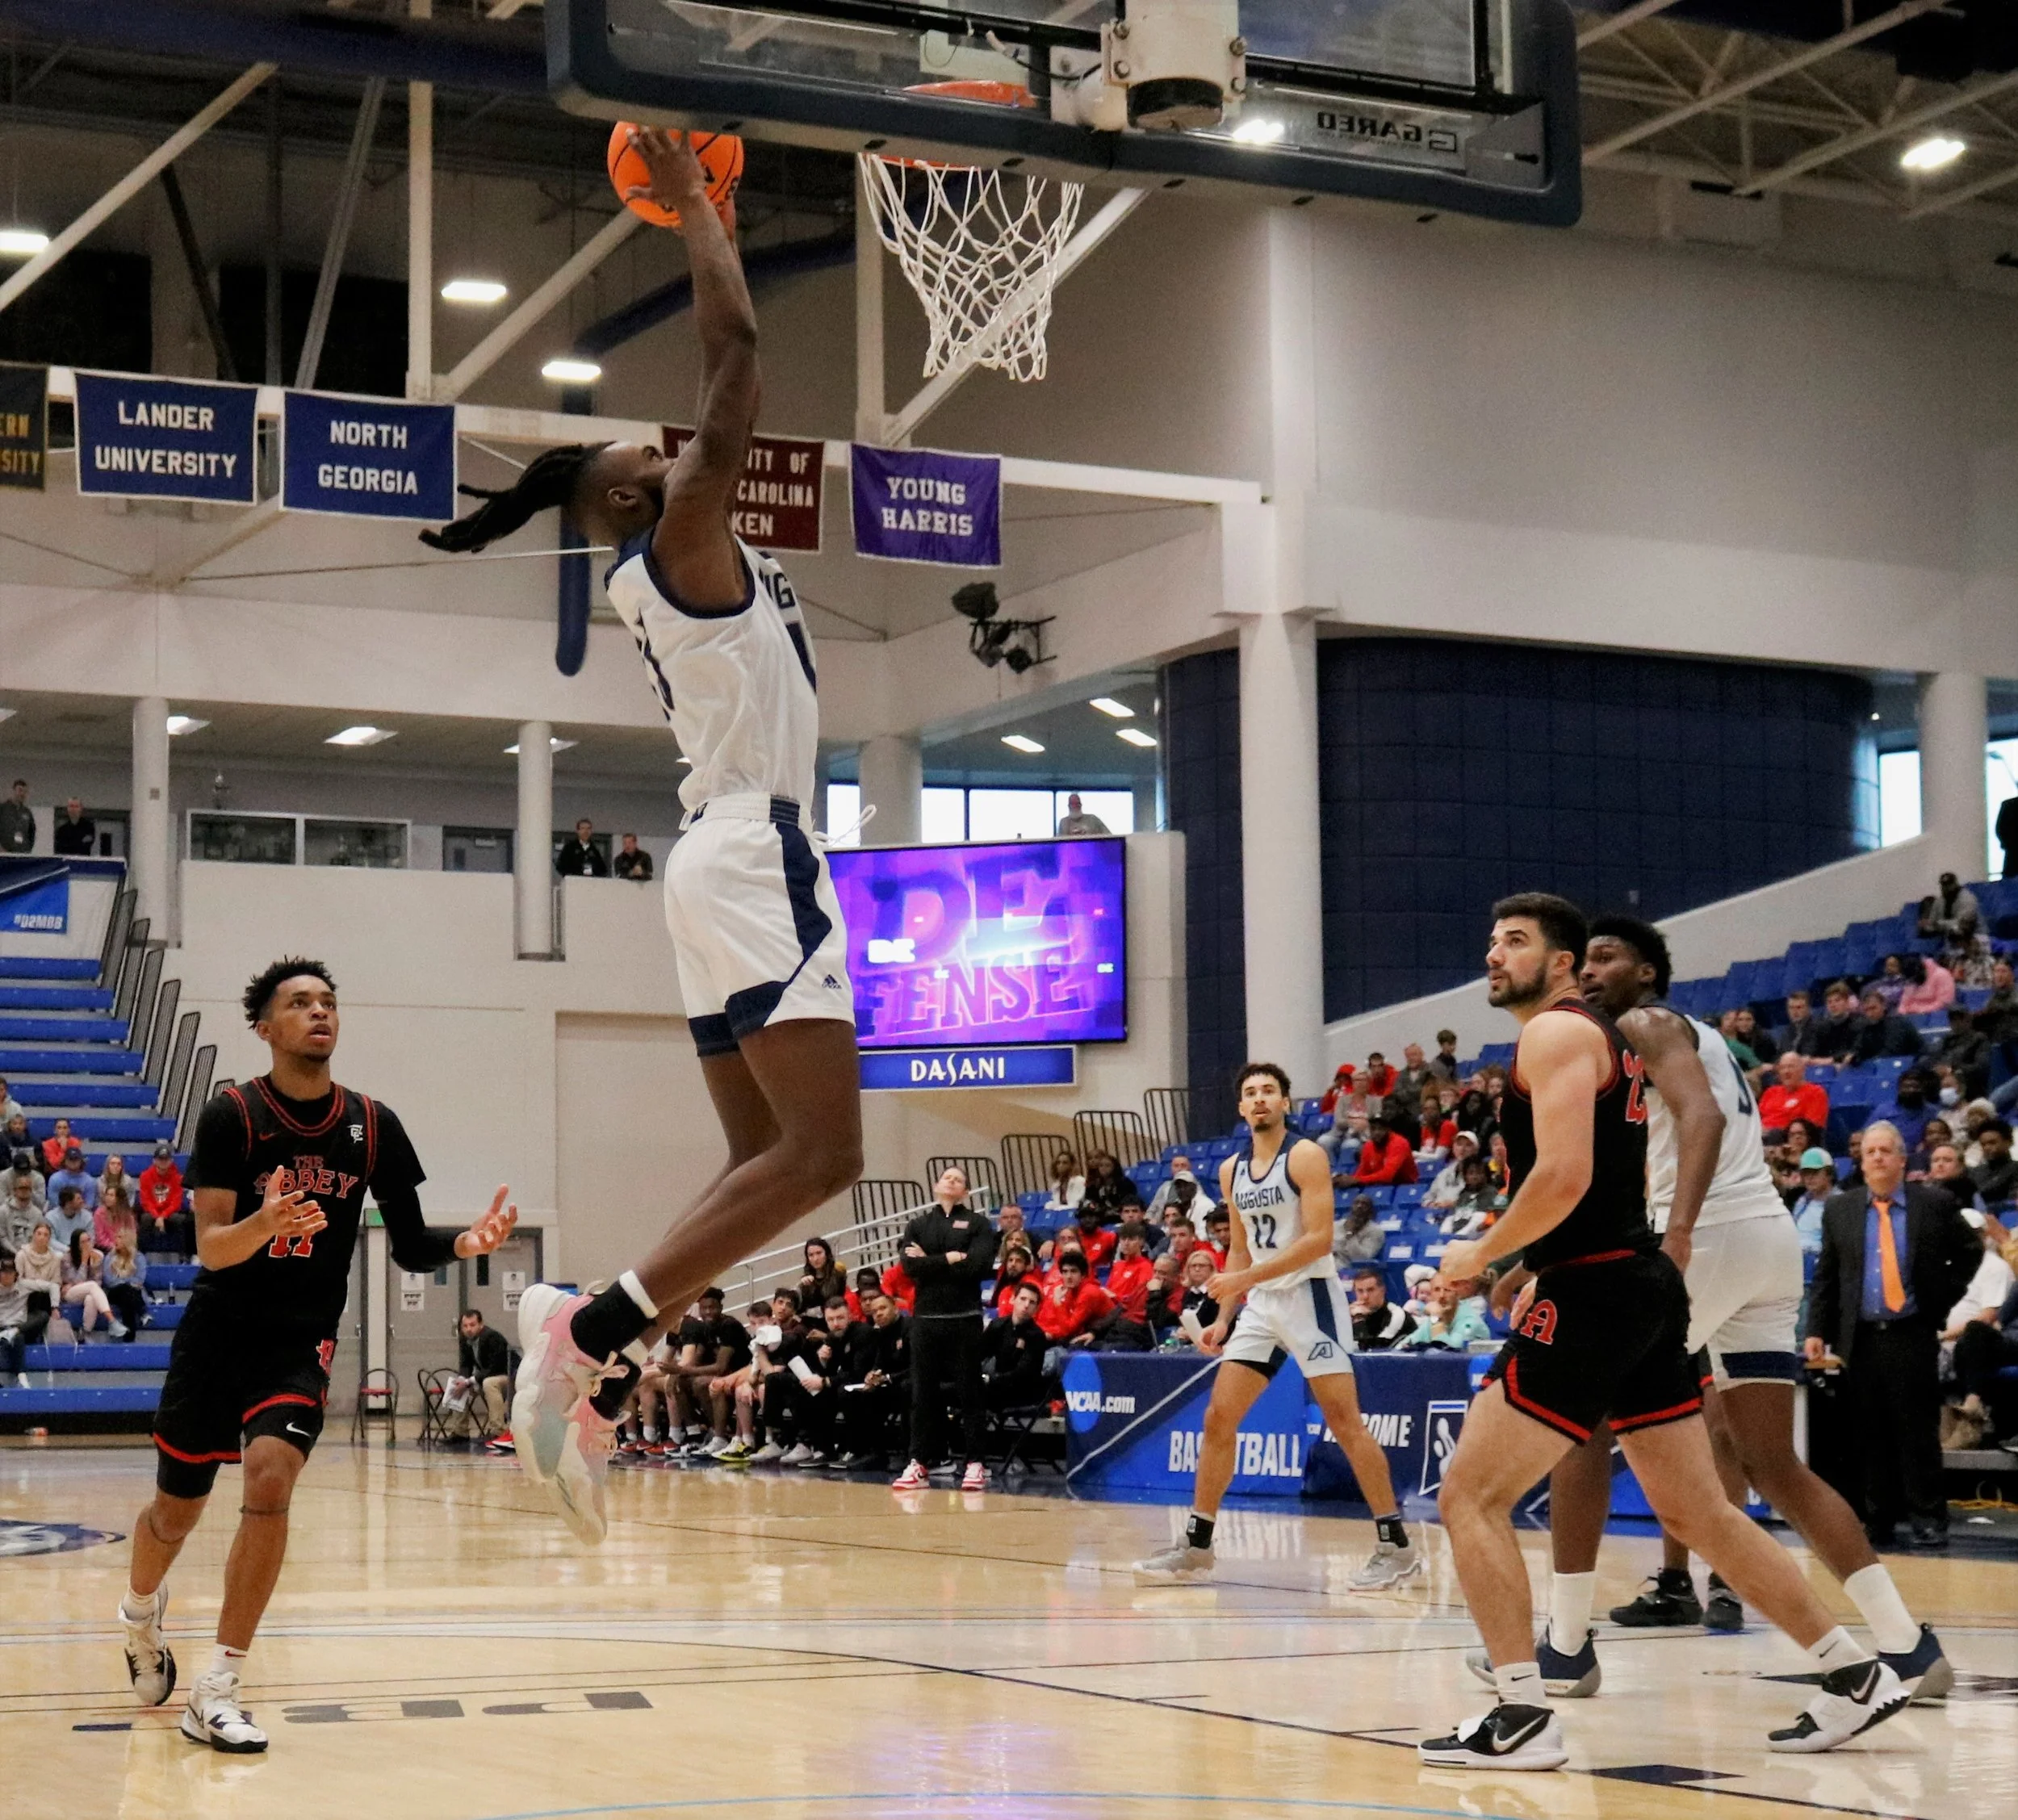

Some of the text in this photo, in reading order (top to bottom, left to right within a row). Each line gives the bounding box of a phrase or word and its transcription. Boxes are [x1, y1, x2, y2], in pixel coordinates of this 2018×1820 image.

[119, 401, 214, 432] LANDER
[330, 420, 408, 450] NORTH
[94, 445, 237, 479] UNIVERSITY
[789, 451, 810, 475] OF
[318, 463, 418, 495] GEORGIA
[737, 479, 814, 508] CAROLINA
[886, 476, 966, 505] YOUNG
[881, 507, 973, 537] HARRIS
[911, 1052, 1005, 1086] DASANI
[293, 1155, 324, 1169] THE
[253, 1169, 358, 1199] ABBEY
[1235, 1185, 1285, 1211] AUGUSTA
[1250, 1213, 1278, 1249] 12
[1065, 1391, 1136, 1414] NCAA.com
[1168, 1430, 1303, 1478] BATBALL
